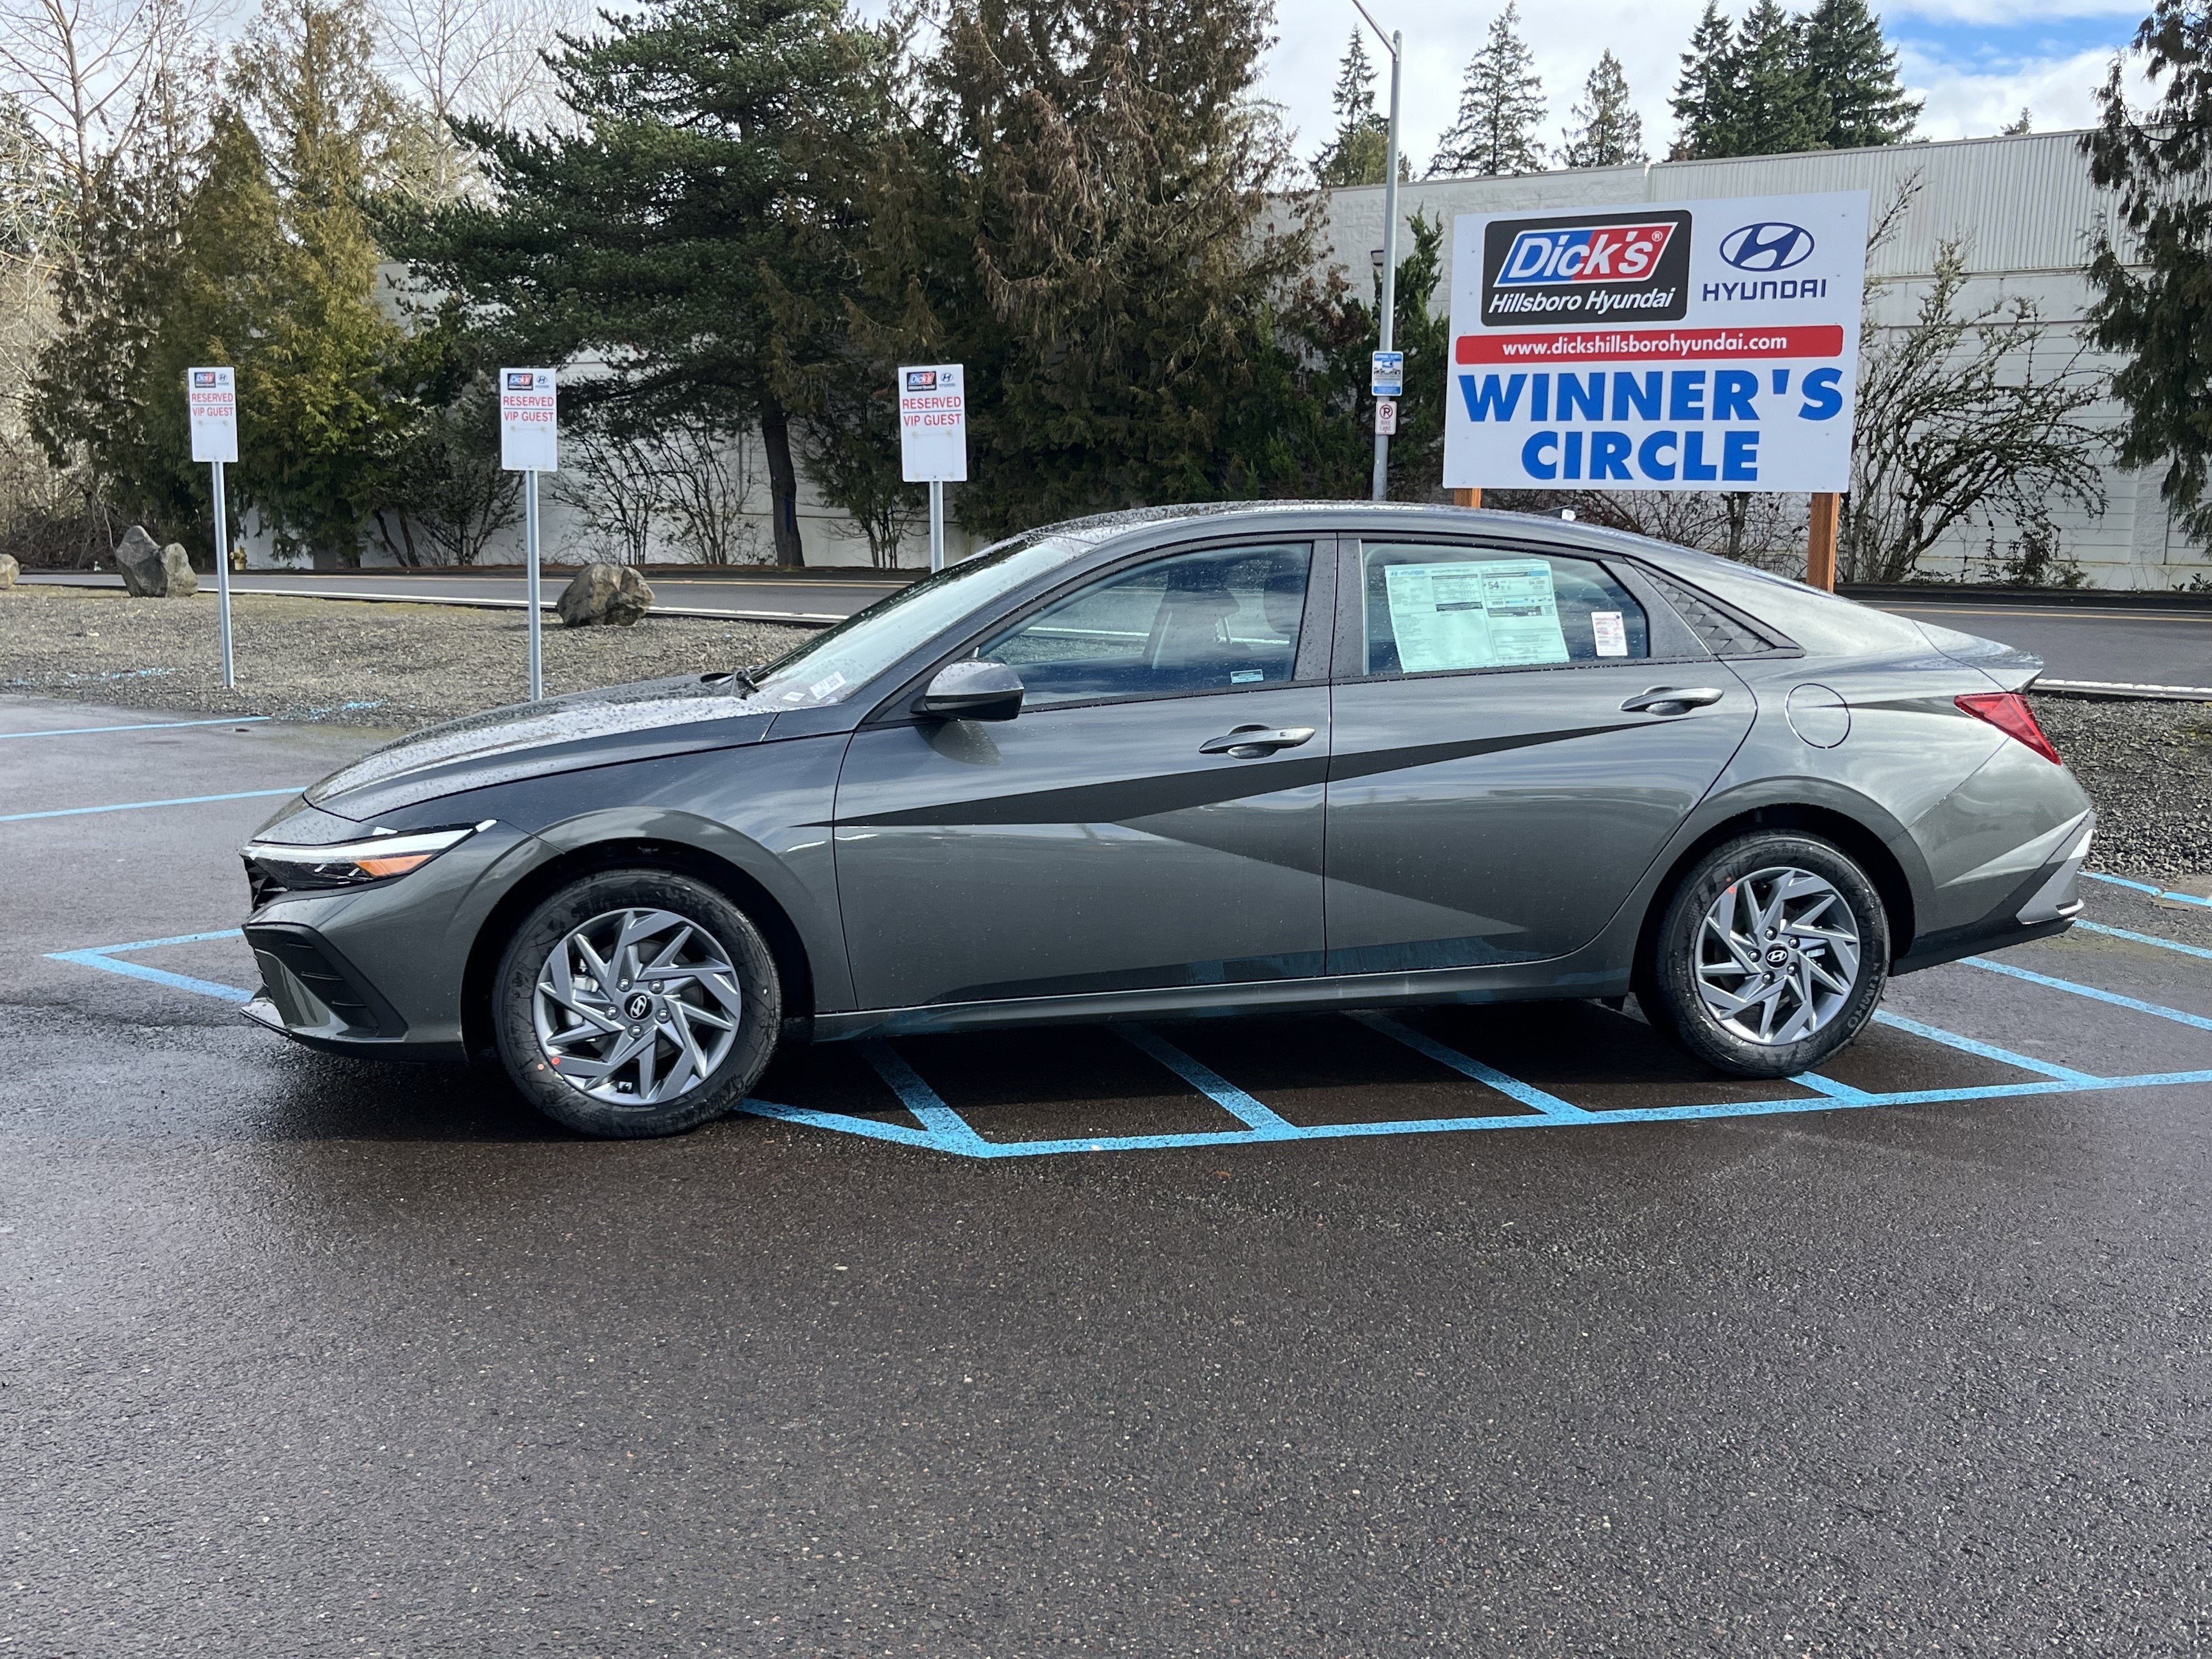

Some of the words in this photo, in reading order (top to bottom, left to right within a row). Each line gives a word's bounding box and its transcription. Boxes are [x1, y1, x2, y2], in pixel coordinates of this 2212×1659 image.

[1508, 230, 1654, 279] Dick's
[1702, 279, 1826, 302] HYUNDAI
[1488, 292, 1583, 313] Hillsboro
[1585, 287, 1676, 315] Hyundai
[1502, 334, 1787, 358] www.dickshillsborohyundai.com
[191, 393, 234, 402] RESERVED
[1458, 367, 1843, 422] WINNER'S
[503, 396, 554, 407] RESERVED
[902, 396, 961, 409] RESERVED
[192, 407, 205, 416] VIP
[207, 407, 234, 416] GUEST
[504, 411, 518, 421] VIP
[522, 411, 554, 422] GUEST
[903, 415, 920, 426] VIP
[924, 414, 961, 426] GUEST
[1521, 430, 1760, 482] CIRCLE
[1488, 581, 1499, 589] 54
